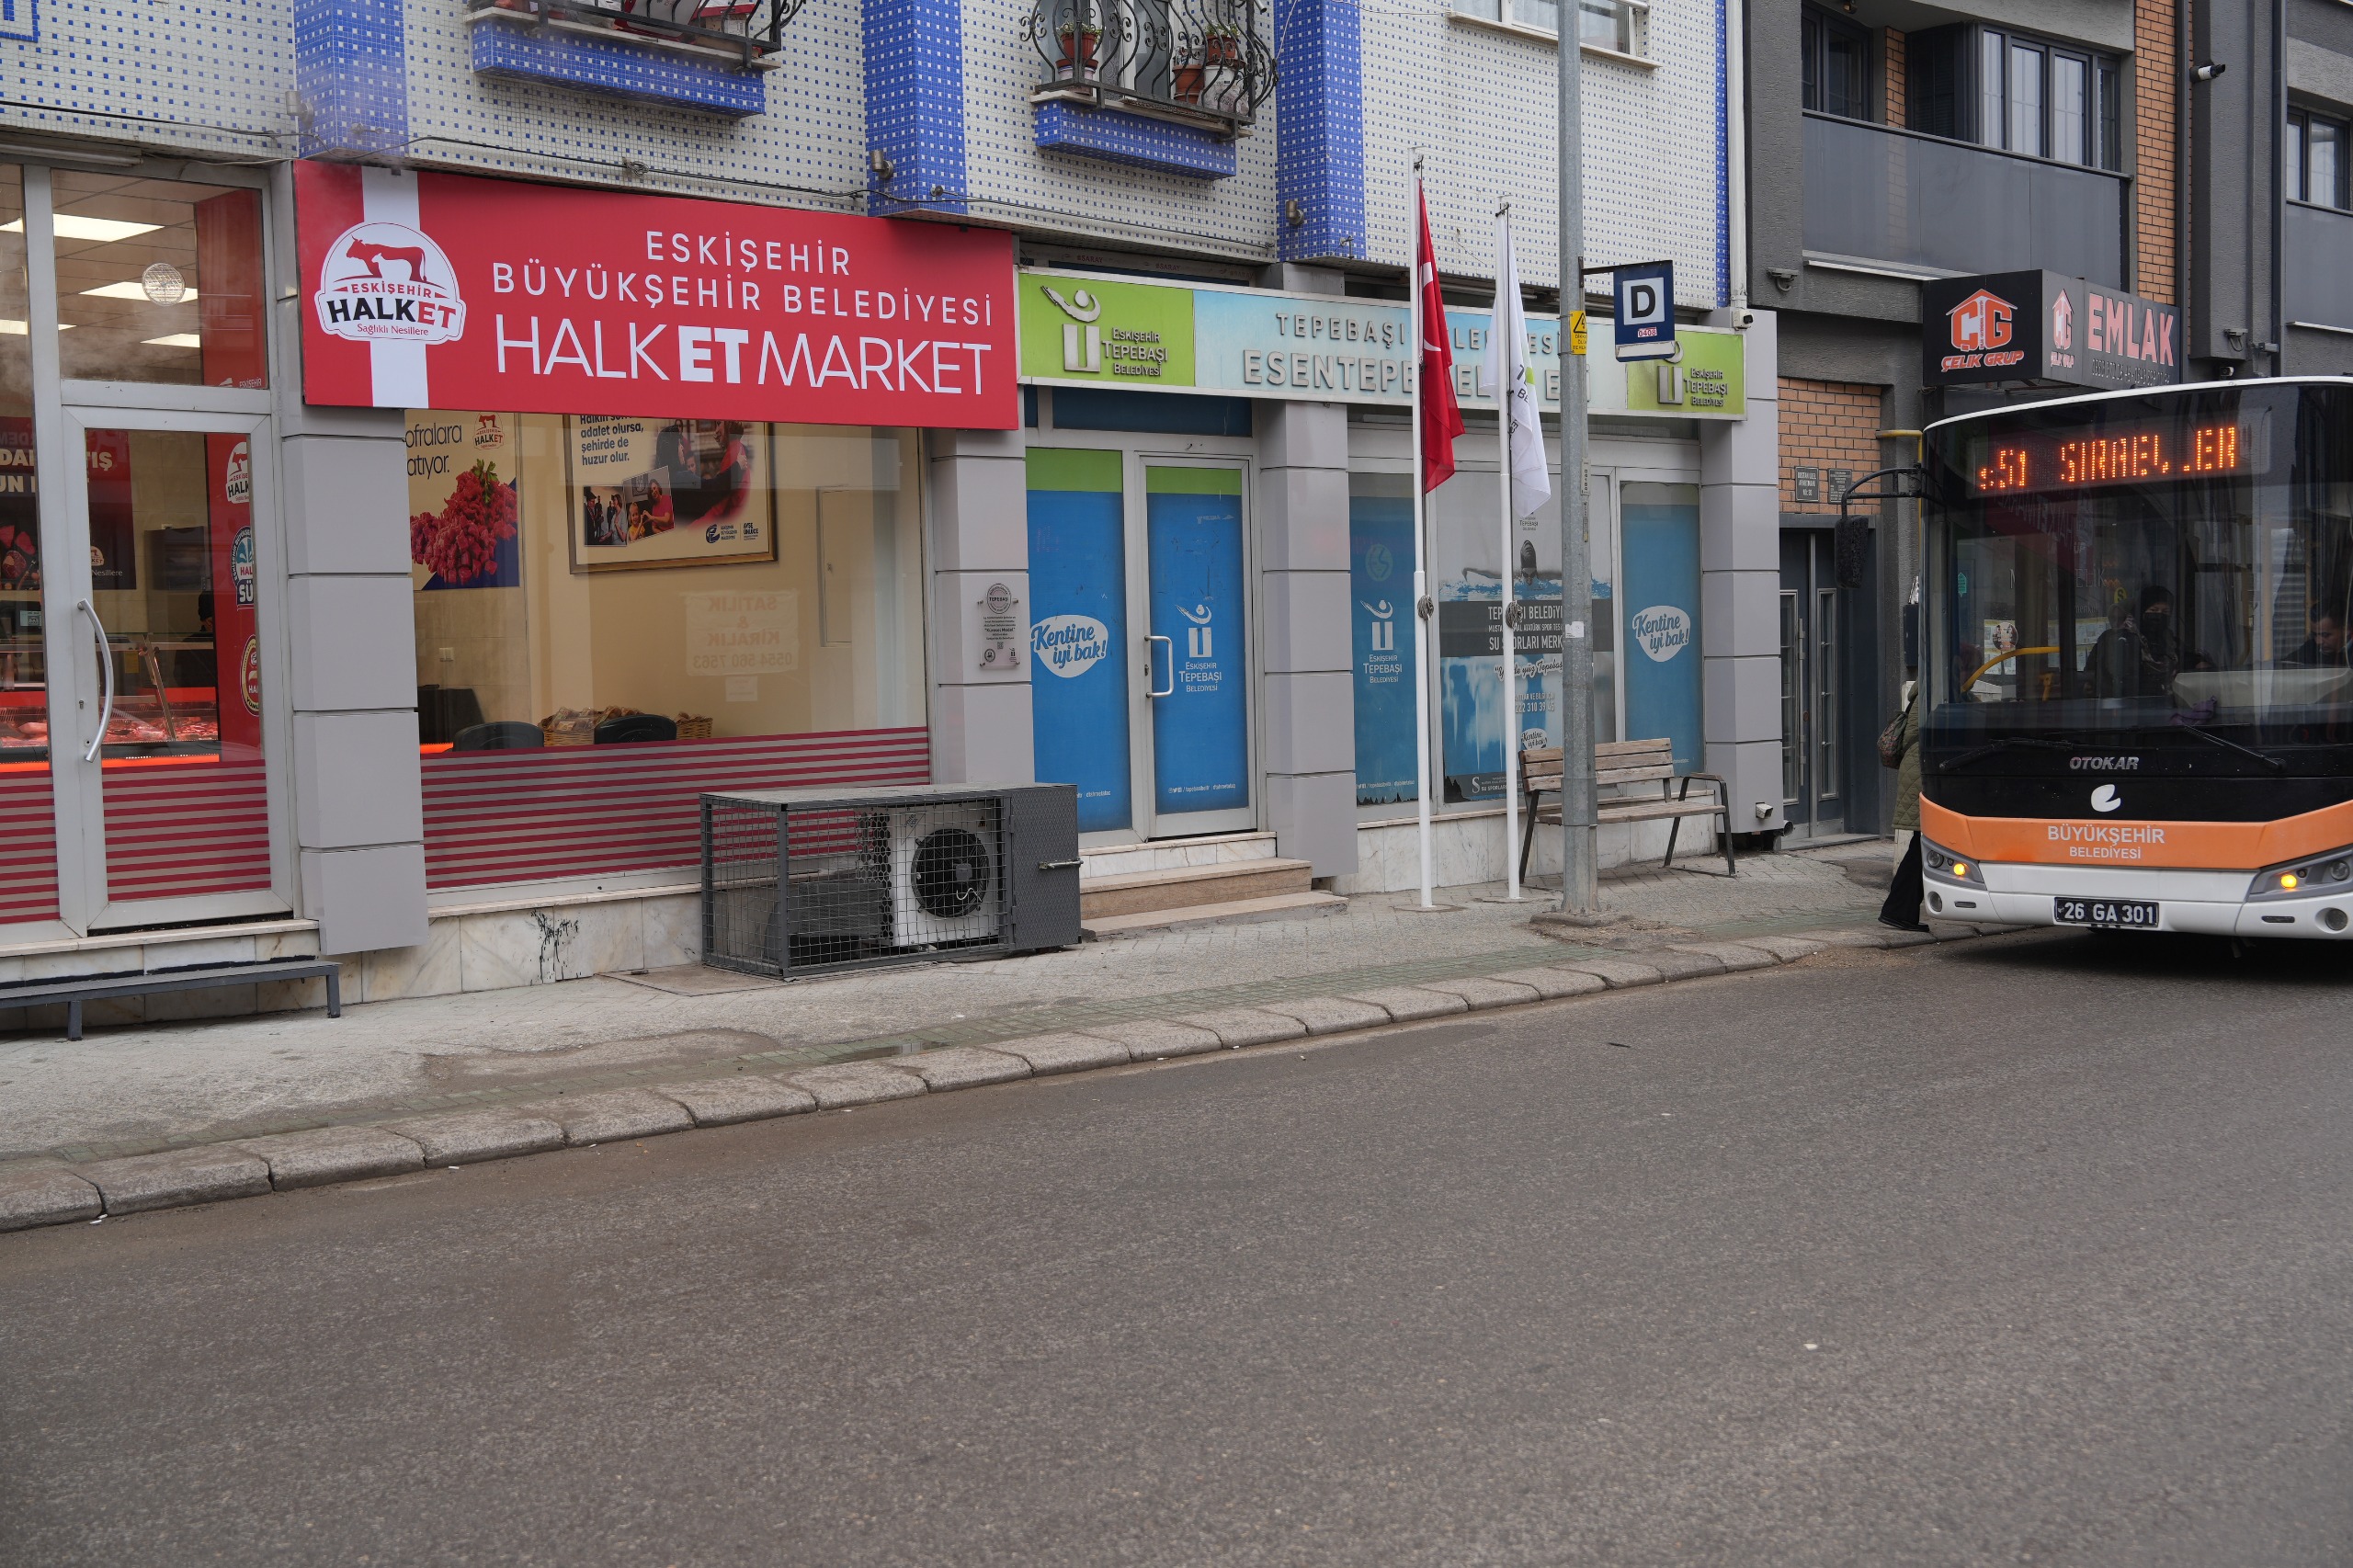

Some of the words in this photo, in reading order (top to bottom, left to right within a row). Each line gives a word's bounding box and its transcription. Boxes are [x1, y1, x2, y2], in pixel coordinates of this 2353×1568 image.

[646, 231, 850, 276] ESKİŞEHİR
[351, 281, 432, 298] ESKİŞEHİR
[493, 258, 761, 311] BÜYÜKŞEHİR
[783, 283, 992, 326] BELEDİYESİ
[1631, 284, 1656, 319] D
[326, 297, 457, 329] HALKET
[358, 324, 389, 335] Sağlıklı
[392, 324, 429, 335] Nesillere
[1112, 327, 1160, 344] ESKİŞEHİR
[1276, 312, 1405, 348] TEPEBAŞI
[2087, 292, 2174, 367] EMLAK
[1101, 340, 1168, 365] TEPEBAŞI
[1984, 350, 2025, 367] GRUP
[1113, 362, 1162, 377] BELEDİYESİ
[1244, 349, 1413, 394] ESENTEPE
[1684, 379, 1728, 398] TEPEBAŞI
[405, 423, 462, 448] ofralara
[581, 425, 610, 438] adalet
[612, 423, 643, 435] olursa,
[474, 434, 503, 446] HALKET
[581, 438, 615, 453] şehirde
[618, 437, 629, 448] de
[407, 455, 449, 480] atıyor.
[582, 454, 608, 466] huzur
[610, 451, 630, 463] olur.
[1633, 613, 1681, 638] Kentine
[1030, 623, 1096, 651] Kentine
[1489, 636, 1500, 651] SU
[1650, 631, 1664, 653] iyi
[1665, 628, 1689, 647] bak!
[1052, 644, 1074, 669] iyi
[1074, 640, 1107, 662] bak!
[1369, 654, 1398, 663] ESKİŞEHİR
[1186, 662, 1217, 671] ESKİŞEHİR
[1363, 663, 1403, 676] TEPEBAŞI
[1178, 671, 1222, 684] TEPEBAŞI
[1186, 684, 1218, 693] BELEDİYESİ
[2069, 756, 2140, 770] OTOKAR
[2048, 824, 2165, 846] BÜYÜKŞEHİR
[2069, 846, 2142, 859] BELEDİYESİ
[2064, 902, 2085, 920] 26
[2092, 903, 2118, 922] GA
[2121, 905, 2154, 924] 301
